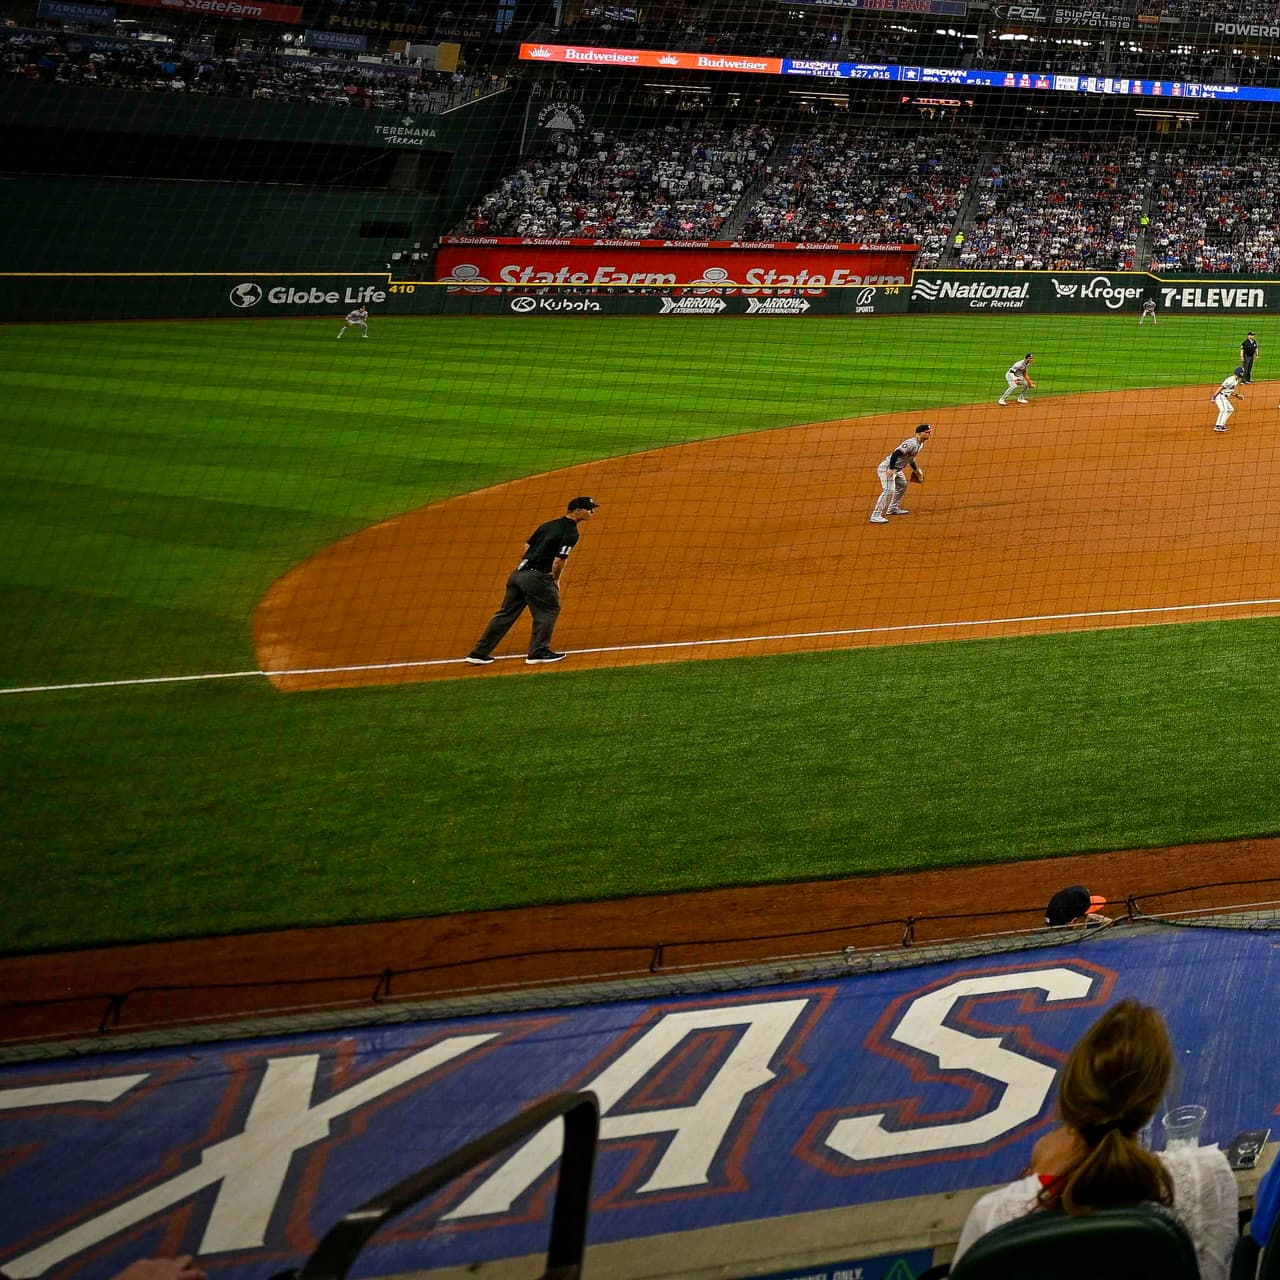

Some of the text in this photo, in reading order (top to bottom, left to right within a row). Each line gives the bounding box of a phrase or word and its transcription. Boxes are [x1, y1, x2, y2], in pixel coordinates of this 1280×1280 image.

[1007, 6, 1046, 20] PGL
[1055, 8, 1131, 22] ShipPGL.com
[1054, 17, 1130, 29] 877.701.1919
[312, 32, 361, 45] TEREMANA
[565, 48, 640, 64] Budweiser
[697, 56, 768, 71] Budweiser
[923, 68, 968, 77] BROWN
[1202, 85, 1238, 94] WALSH
[374, 125, 437, 138] TEREMANA
[267, 285, 386, 304] Globe Life
[388, 285, 415, 294] 410
[884, 287, 899, 296] 374
[939, 280, 1029, 300] National
[1081, 277, 1144, 309] Kroger
[540, 297, 602, 311] Kubota
[677, 298, 719, 308] ARROW
[763, 298, 803, 308] ARROW
[969, 300, 1024, 308] Car Rental
